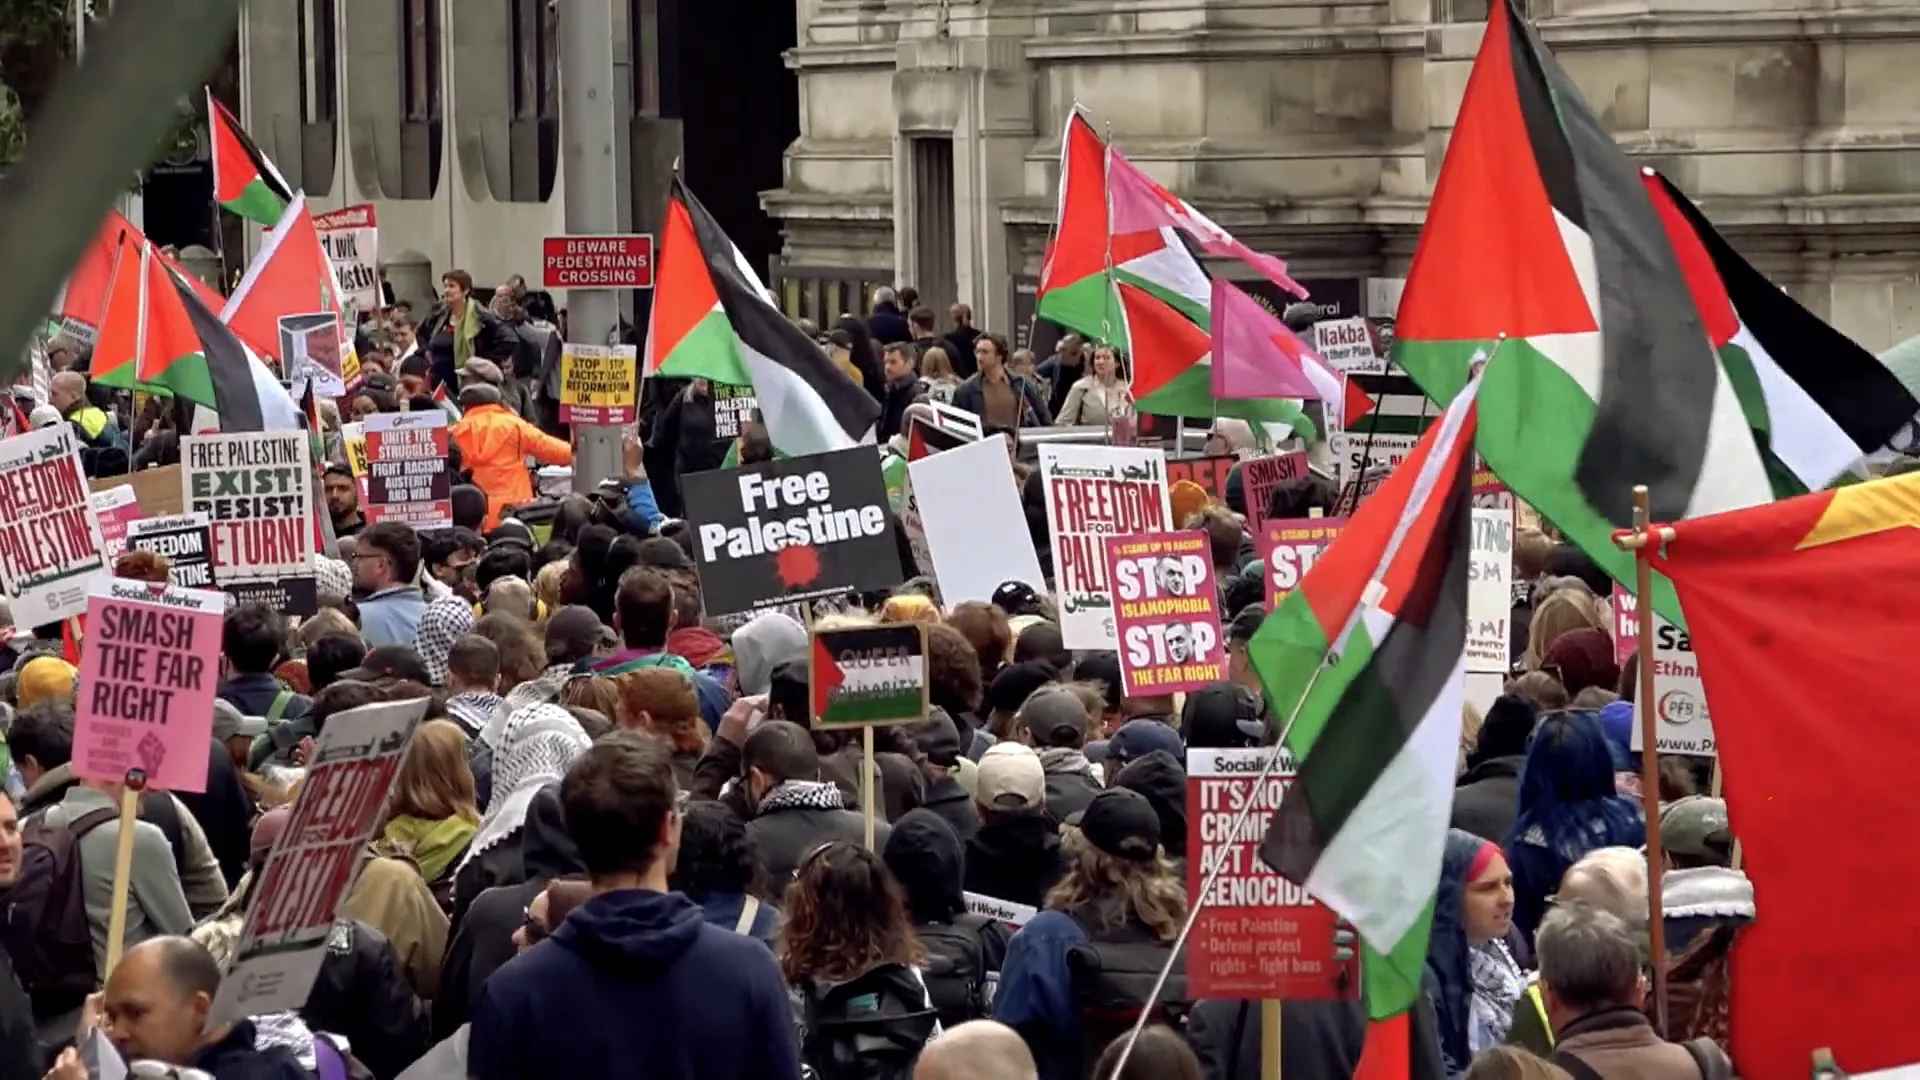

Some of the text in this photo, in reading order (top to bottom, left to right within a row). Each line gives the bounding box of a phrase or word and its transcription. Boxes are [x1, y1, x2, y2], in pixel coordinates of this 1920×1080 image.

[567, 241, 627, 253] BEWARE
[547, 255, 647, 268] PEDESTRIANS
[559, 270, 636, 282] CROSSING
[1319, 324, 1365, 346] Nakba
[573, 359, 600, 369] STOP
[569, 369, 604, 380] RACIST
[567, 380, 606, 392] REFORM
[577, 393, 591, 403] UK
[715, 397, 758, 411] PALESTIN
[715, 409, 752, 424] WILL BE
[381, 428, 433, 445] UNITE THE
[716, 422, 738, 438] FREE
[190, 437, 300, 468] FREE PALESTINE
[378, 442, 437, 460] STRUGGLES
[372, 458, 445, 477] FIGHT RACISM
[1249, 457, 1297, 486] SMASH
[0, 454, 86, 524] REEDOM
[192, 467, 302, 498] EXIST!
[385, 475, 434, 490] AUSTERITY
[738, 470, 830, 513] Free
[388, 487, 432, 502] AND WAR
[19, 506, 40, 521] FOR
[1050, 477, 1166, 536] FREEDOM
[699, 503, 885, 563] Palestine
[1087, 524, 1114, 534] FOR
[211, 517, 305, 567] ETURN!
[1120, 597, 1212, 618] ISLAMOPHOBIA
[100, 604, 194, 651] SMASH
[840, 645, 910, 670] QUEER
[97, 643, 204, 692] THE FAR
[1131, 663, 1220, 686] THE FAR RIGHT
[91, 682, 174, 725] RIGHT
[1200, 780, 1247, 810] IT'S
[979, 902, 1016, 919] Worker
[1210, 918, 1298, 933] Free Palestine
[1210, 937, 1302, 955] Defend protest
[1210, 957, 1246, 977] rights
[1259, 956, 1289, 976] fight
[1292, 957, 1322, 973] bans
